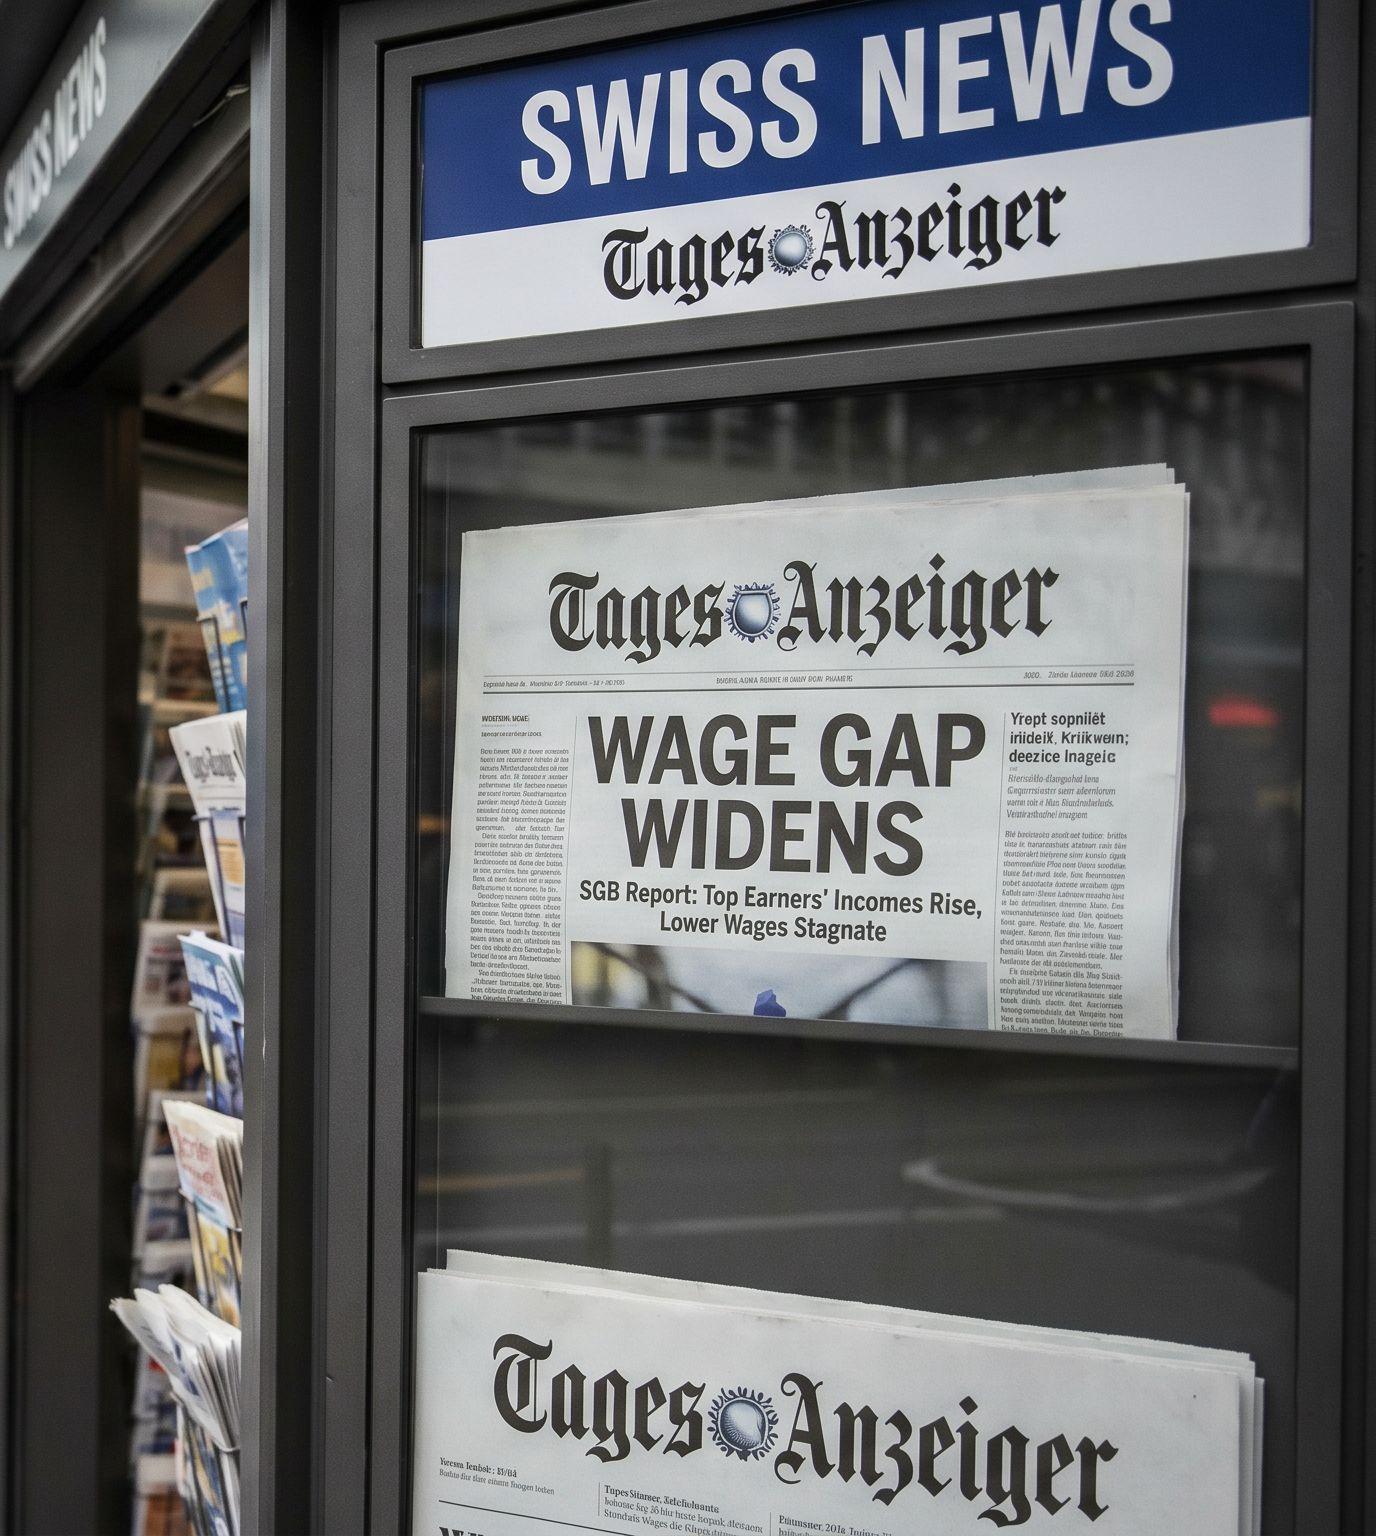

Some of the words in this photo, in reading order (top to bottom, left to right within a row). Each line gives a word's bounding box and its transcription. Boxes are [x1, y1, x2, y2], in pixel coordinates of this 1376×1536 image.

[521, 48, 818, 195] SWISS
[861, 0, 1174, 146] NEWS
[602, 225, 765, 305] Tages
[812, 182, 1067, 280] Anzeiger
[549, 571, 726, 664] Tages
[776, 553, 1060, 658] Anzeiger
[587, 714, 797, 787] WAGE
[821, 713, 986, 788] GAP
[621, 799, 925, 876] WIDENS
[579, 879, 620, 902] SGB
[626, 881, 698, 908] Report:
[703, 885, 739, 910] Top
[834, 889, 923, 914] Incomes
[930, 892, 983, 918] Rise,
[660, 911, 719, 934] Lower
[724, 914, 788, 938] Wages
[793, 917, 887, 944] Stagnate
[493, 1333, 706, 1463] Tages
[774, 1372, 1120, 1528] Anzeiger
